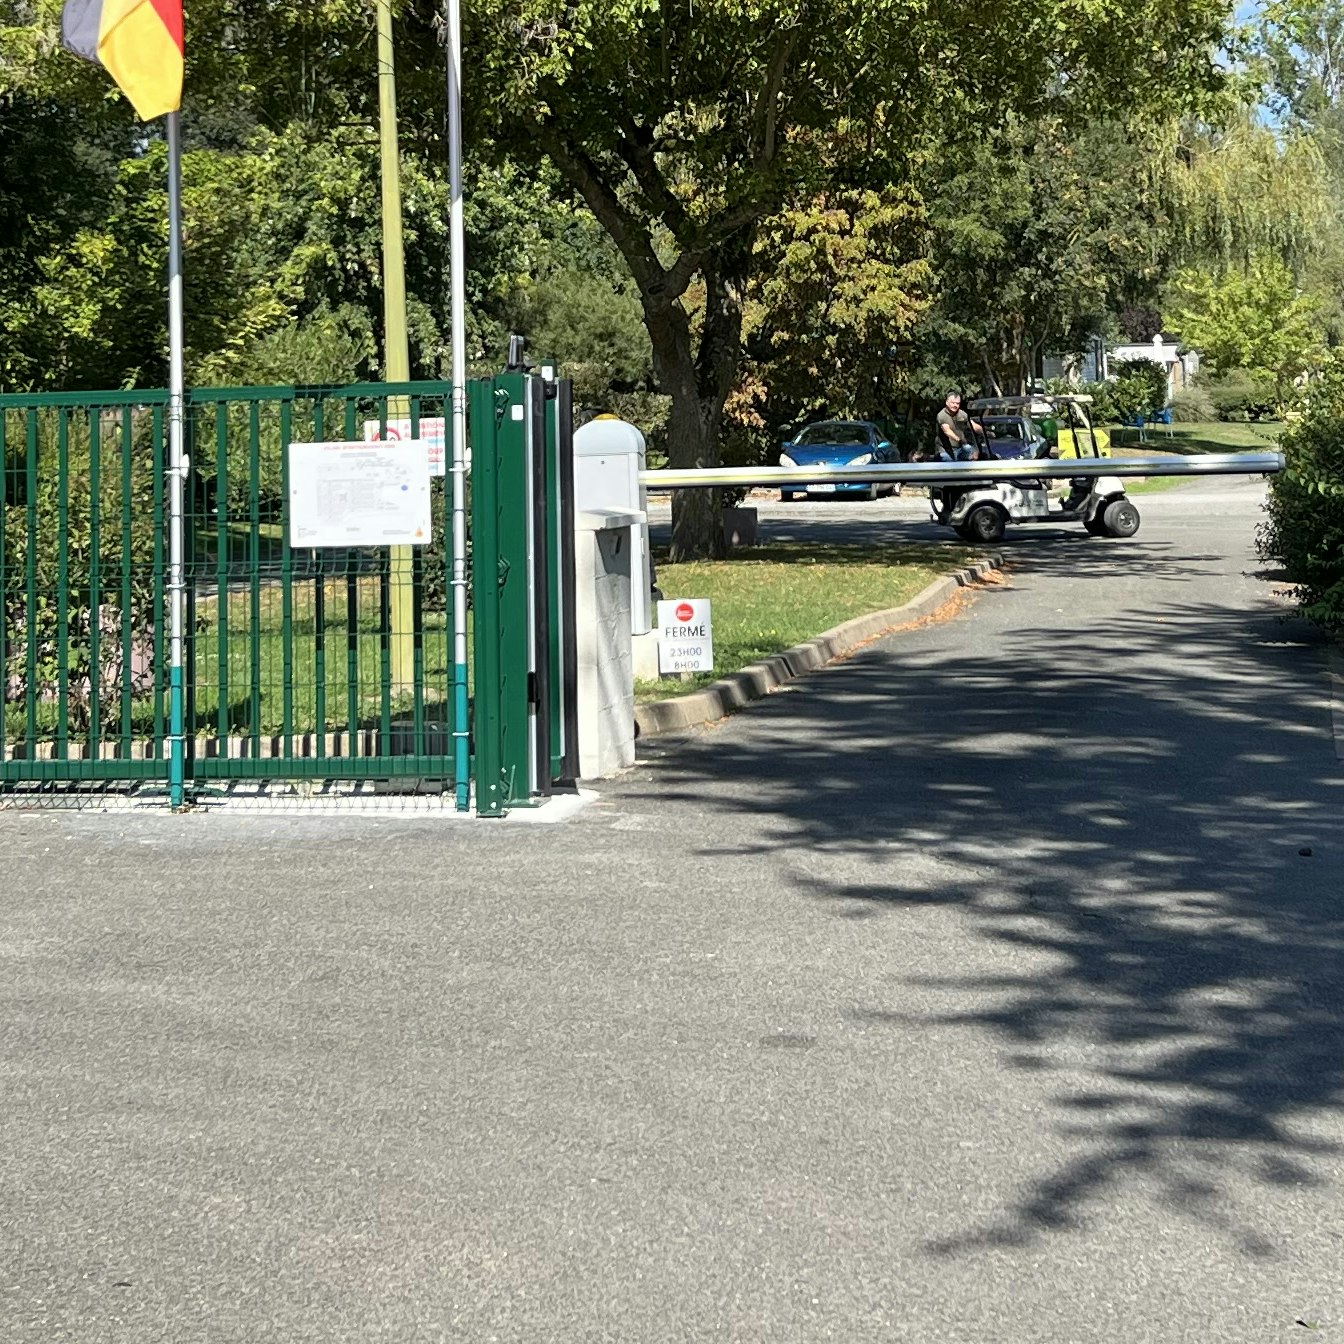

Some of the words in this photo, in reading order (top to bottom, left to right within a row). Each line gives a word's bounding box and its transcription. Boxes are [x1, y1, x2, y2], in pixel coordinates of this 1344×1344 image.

[665, 622, 706, 637] FERMÉ
[670, 647, 702, 656] 23H00
[674, 660, 700, 669] 8H00
